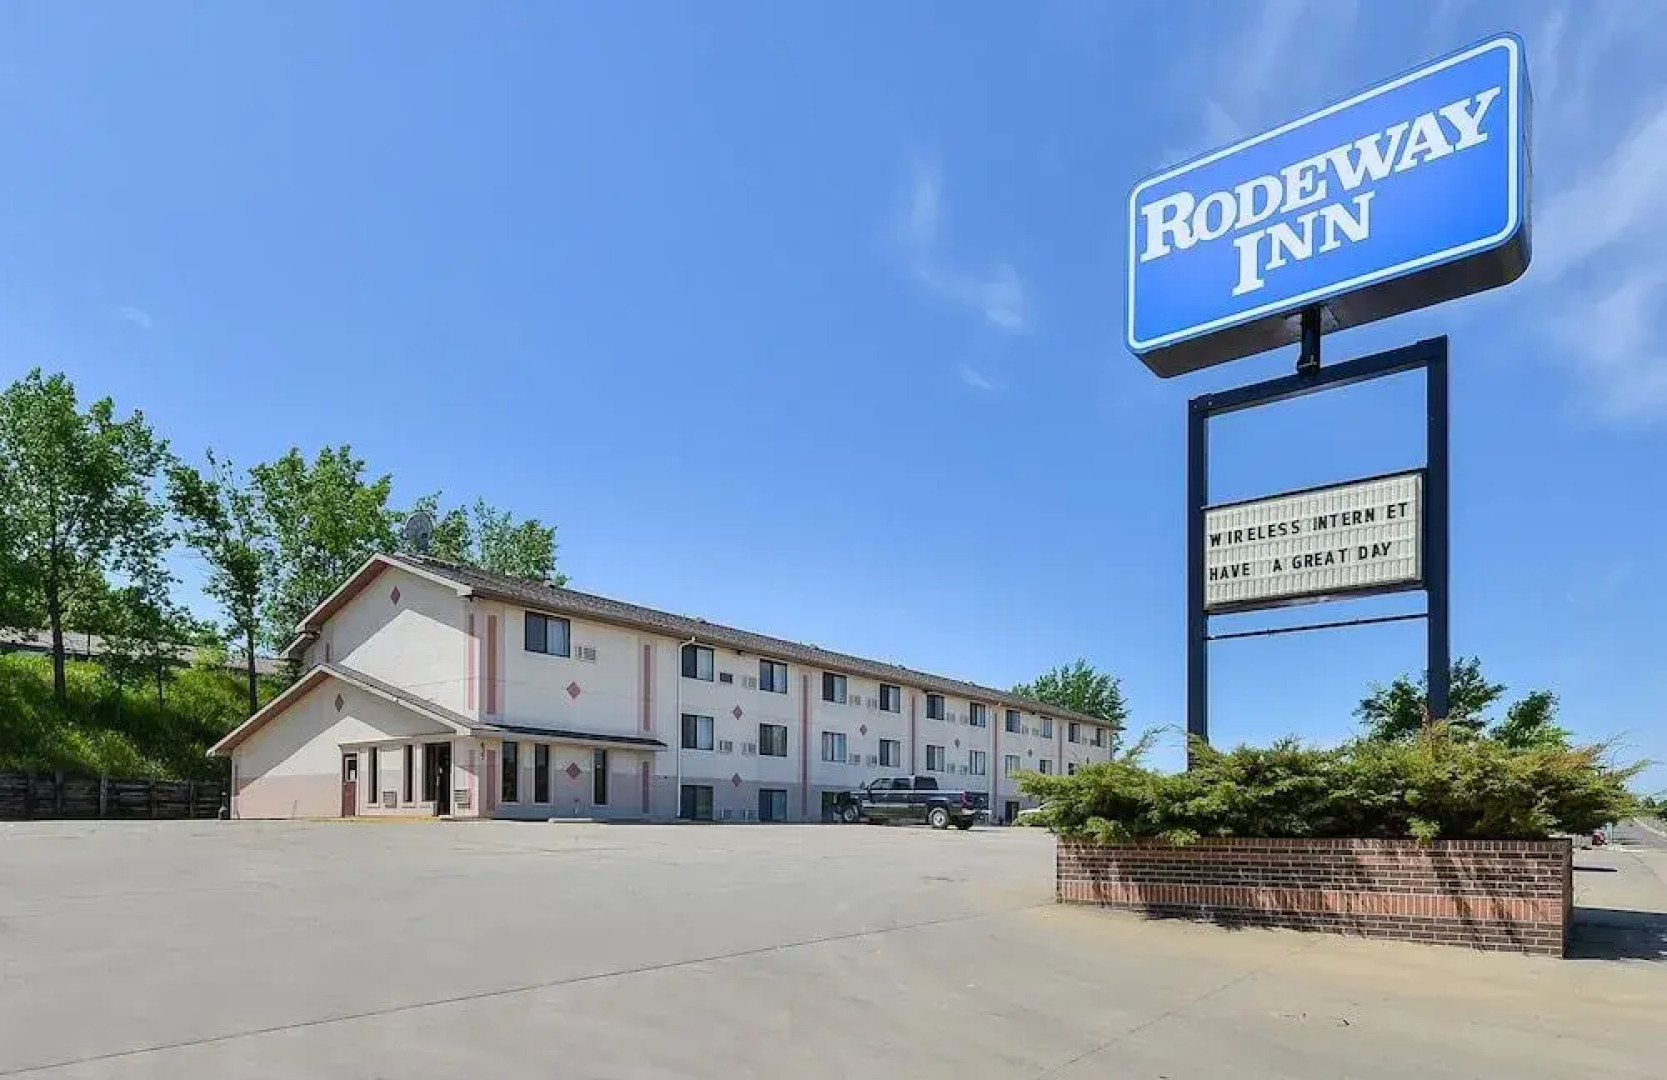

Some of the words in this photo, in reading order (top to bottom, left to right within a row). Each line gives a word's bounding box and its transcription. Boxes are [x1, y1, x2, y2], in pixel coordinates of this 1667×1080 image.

[1140, 86, 1500, 263] RODEWAY
[1232, 191, 1375, 297] INN
[1210, 520, 1299, 547] WIRELESS
[1210, 563, 1250, 580] HAVE
[1273, 559, 1282, 572] A
[1292, 548, 1348, 569] GREAT
[1359, 542, 1392, 560] DAY
